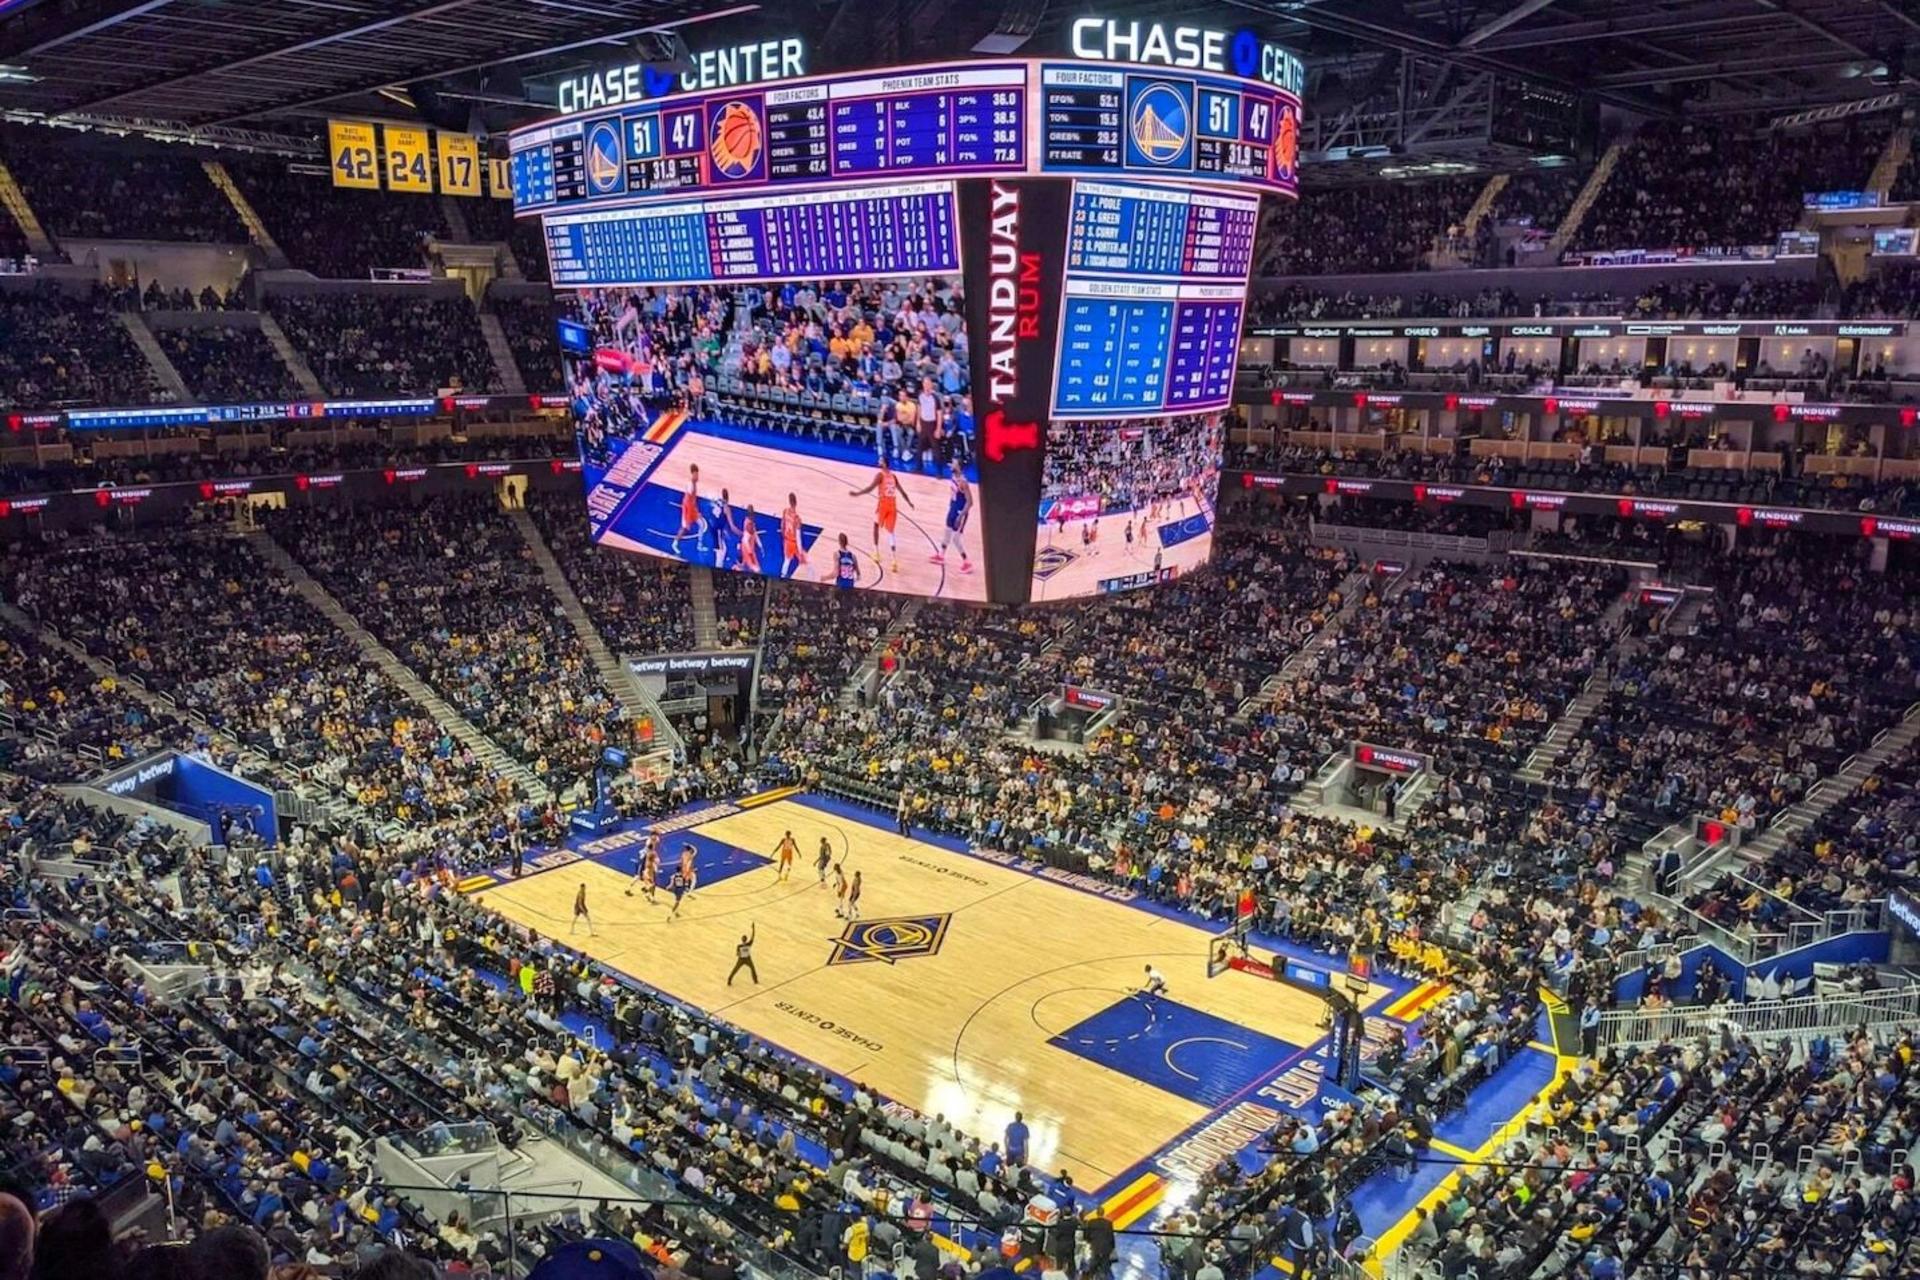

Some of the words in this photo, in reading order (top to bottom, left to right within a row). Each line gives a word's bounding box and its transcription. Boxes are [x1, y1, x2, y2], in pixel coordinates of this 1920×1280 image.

[1072, 18, 1226, 71] CHASE
[882, 79, 912, 91] PHOENIX
[914, 76, 934, 88] TEAM
[935, 74, 960, 86] STATS
[1055, 72, 1078, 82] FOUR
[1079, 73, 1113, 84] FACTORS
[559, 64, 642, 114] CHASE
[790, 88, 819, 100] FACTORS
[992, 93, 1016, 106] 36.0
[1100, 95, 1118, 107] 52.1
[837, 107, 851, 116] AST
[1209, 96, 1229, 132] 51
[896, 120, 906, 129] TO
[1250, 103, 1268, 138] 47
[633, 121, 651, 154] 51
[672, 114, 695, 149] 47
[895, 138, 911, 146] POT
[937, 133, 946, 146] 11
[994, 149, 1016, 162] 77.8
[1229, 143, 1251, 165] 31.9
[337, 146, 374, 179] 42
[391, 151, 427, 183] 24
[652, 159, 676, 180] 31.9
[447, 156, 471, 187] 17
[991, 183, 1020, 402] TANDUAY
[1020, 254, 1041, 338] RUM
[1404, 327, 1430, 336] CHASE
[1511, 327, 1553, 336] ORACLE
[1703, 326, 1740, 335] verizon
[1788, 327, 1809, 335] Adobe
[1838, 326, 1894, 335] ticketmaster
[1670, 404, 1715, 413] TANDUAY
[1791, 406, 1840, 415] TANDUAY
[1634, 502, 1679, 513] TANDUAY
[1754, 510, 1803, 522] TANDUAY
[670, 659, 708, 671] betway
[711, 657, 750, 669] betway
[1373, 751, 1420, 768] TANDUAY
[139, 758, 174, 784] betway
[774, 1000, 822, 1024] CENTER
[831, 1025, 883, 1052] CHASE
